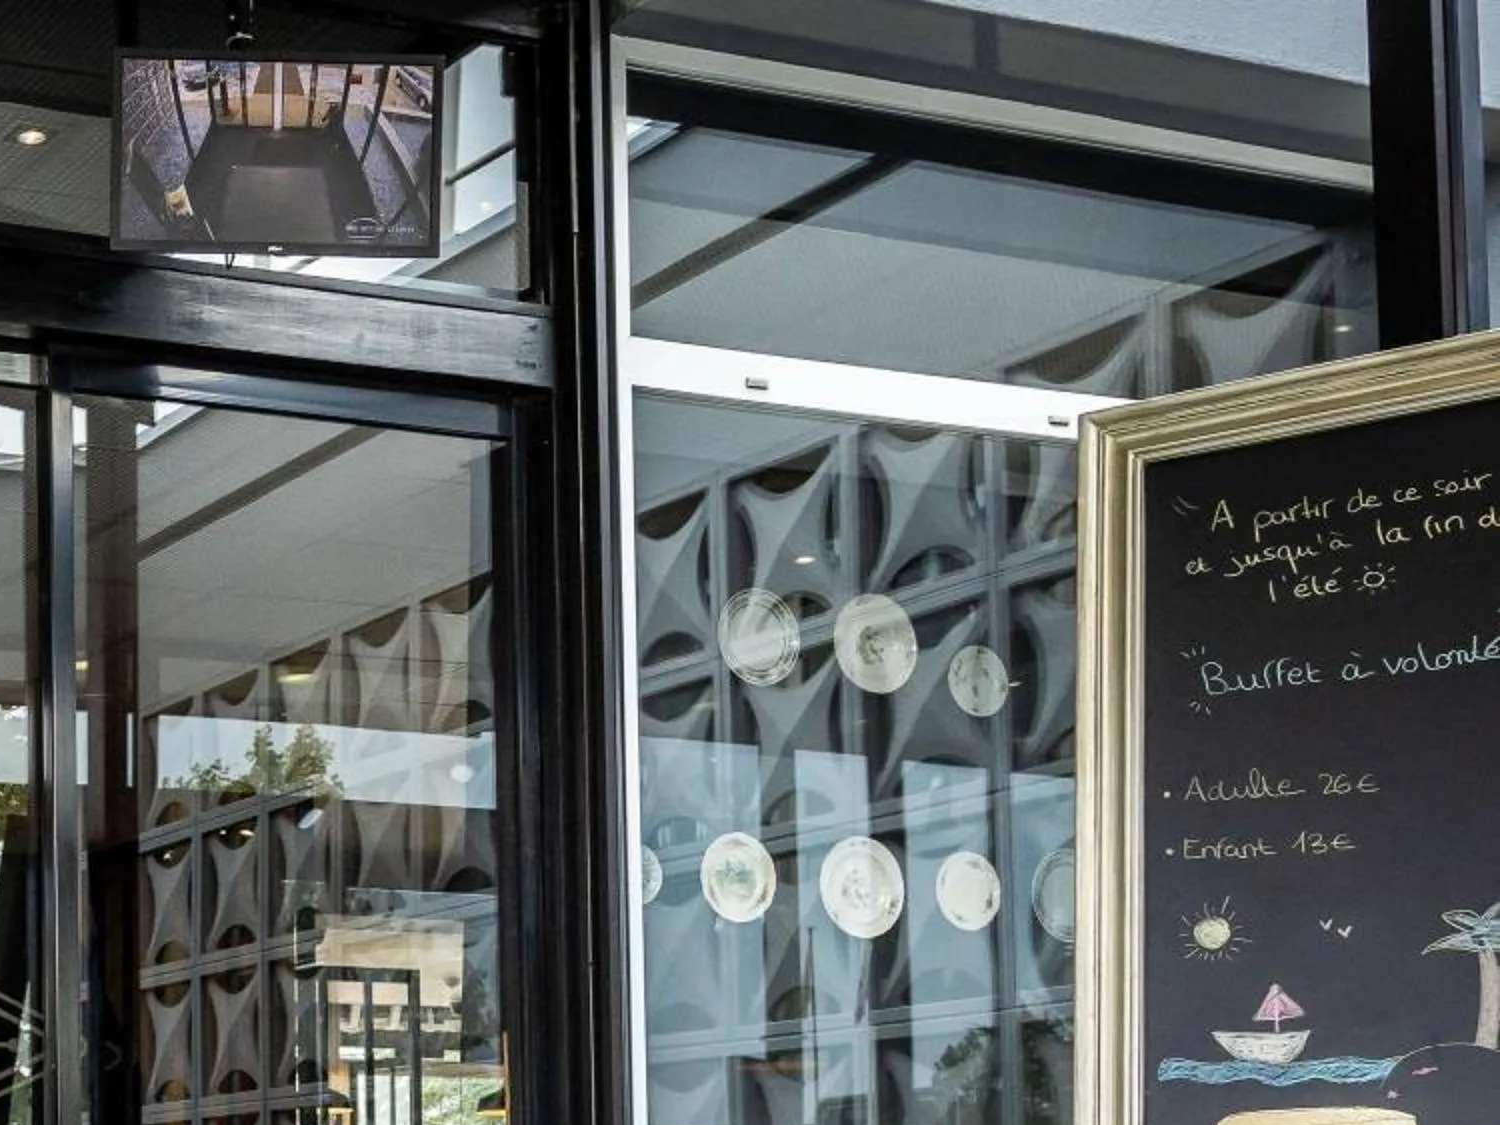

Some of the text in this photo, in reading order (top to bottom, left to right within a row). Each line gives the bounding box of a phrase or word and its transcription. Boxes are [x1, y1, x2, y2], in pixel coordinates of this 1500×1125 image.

[1211, 469, 1492, 543] A partir de ce soir
[1185, 557, 1211, 575] et
[1376, 519, 1411, 545] la
[1424, 515, 1464, 539] fin
[1478, 506, 1500, 529] d
[1268, 567, 1343, 602] l'été
[1201, 656, 1322, 695] Buffet
[1341, 651, 1375, 681] à
[1184, 768, 1381, 802] Adulte 26€
[1183, 831, 1356, 859] Enfant 13€
